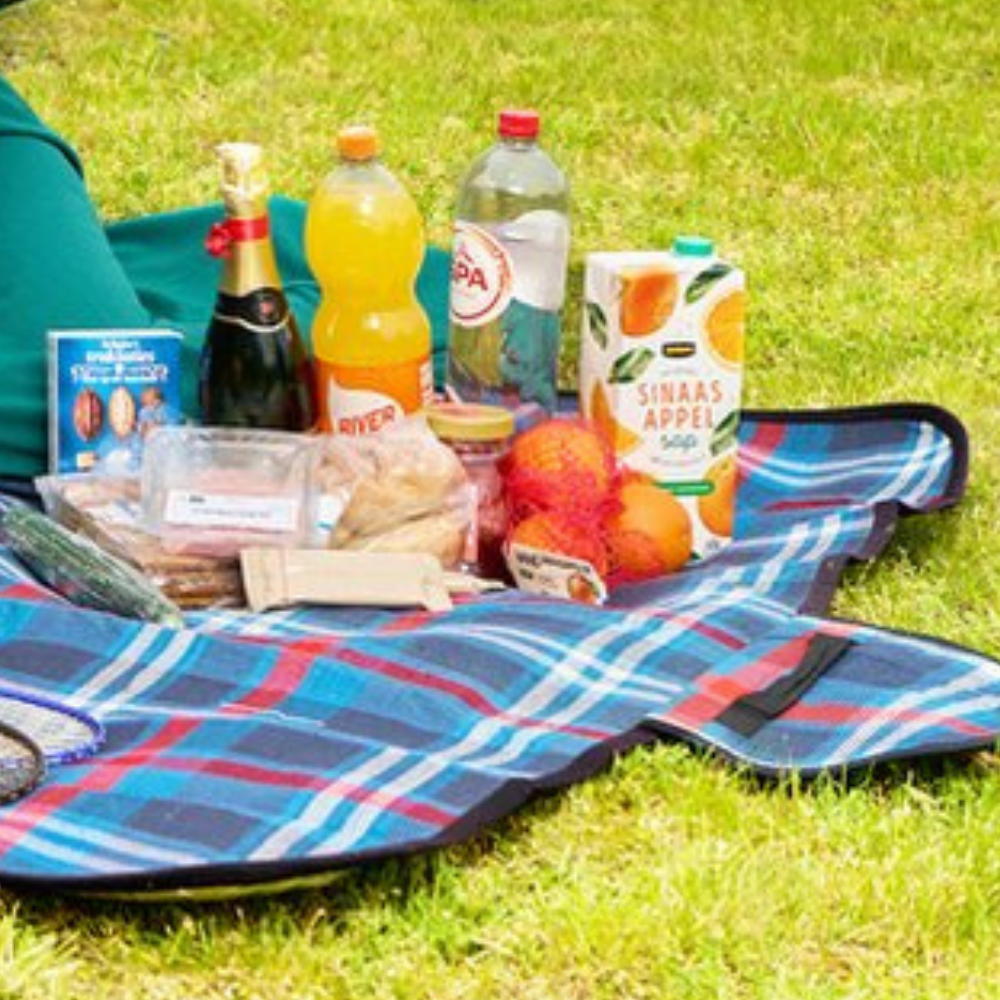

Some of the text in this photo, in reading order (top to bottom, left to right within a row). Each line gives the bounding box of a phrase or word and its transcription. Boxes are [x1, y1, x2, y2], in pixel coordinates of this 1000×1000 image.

[451, 260, 489, 292] PA
[636, 379, 723, 407] SINAAS
[643, 405, 713, 431] APPEL
